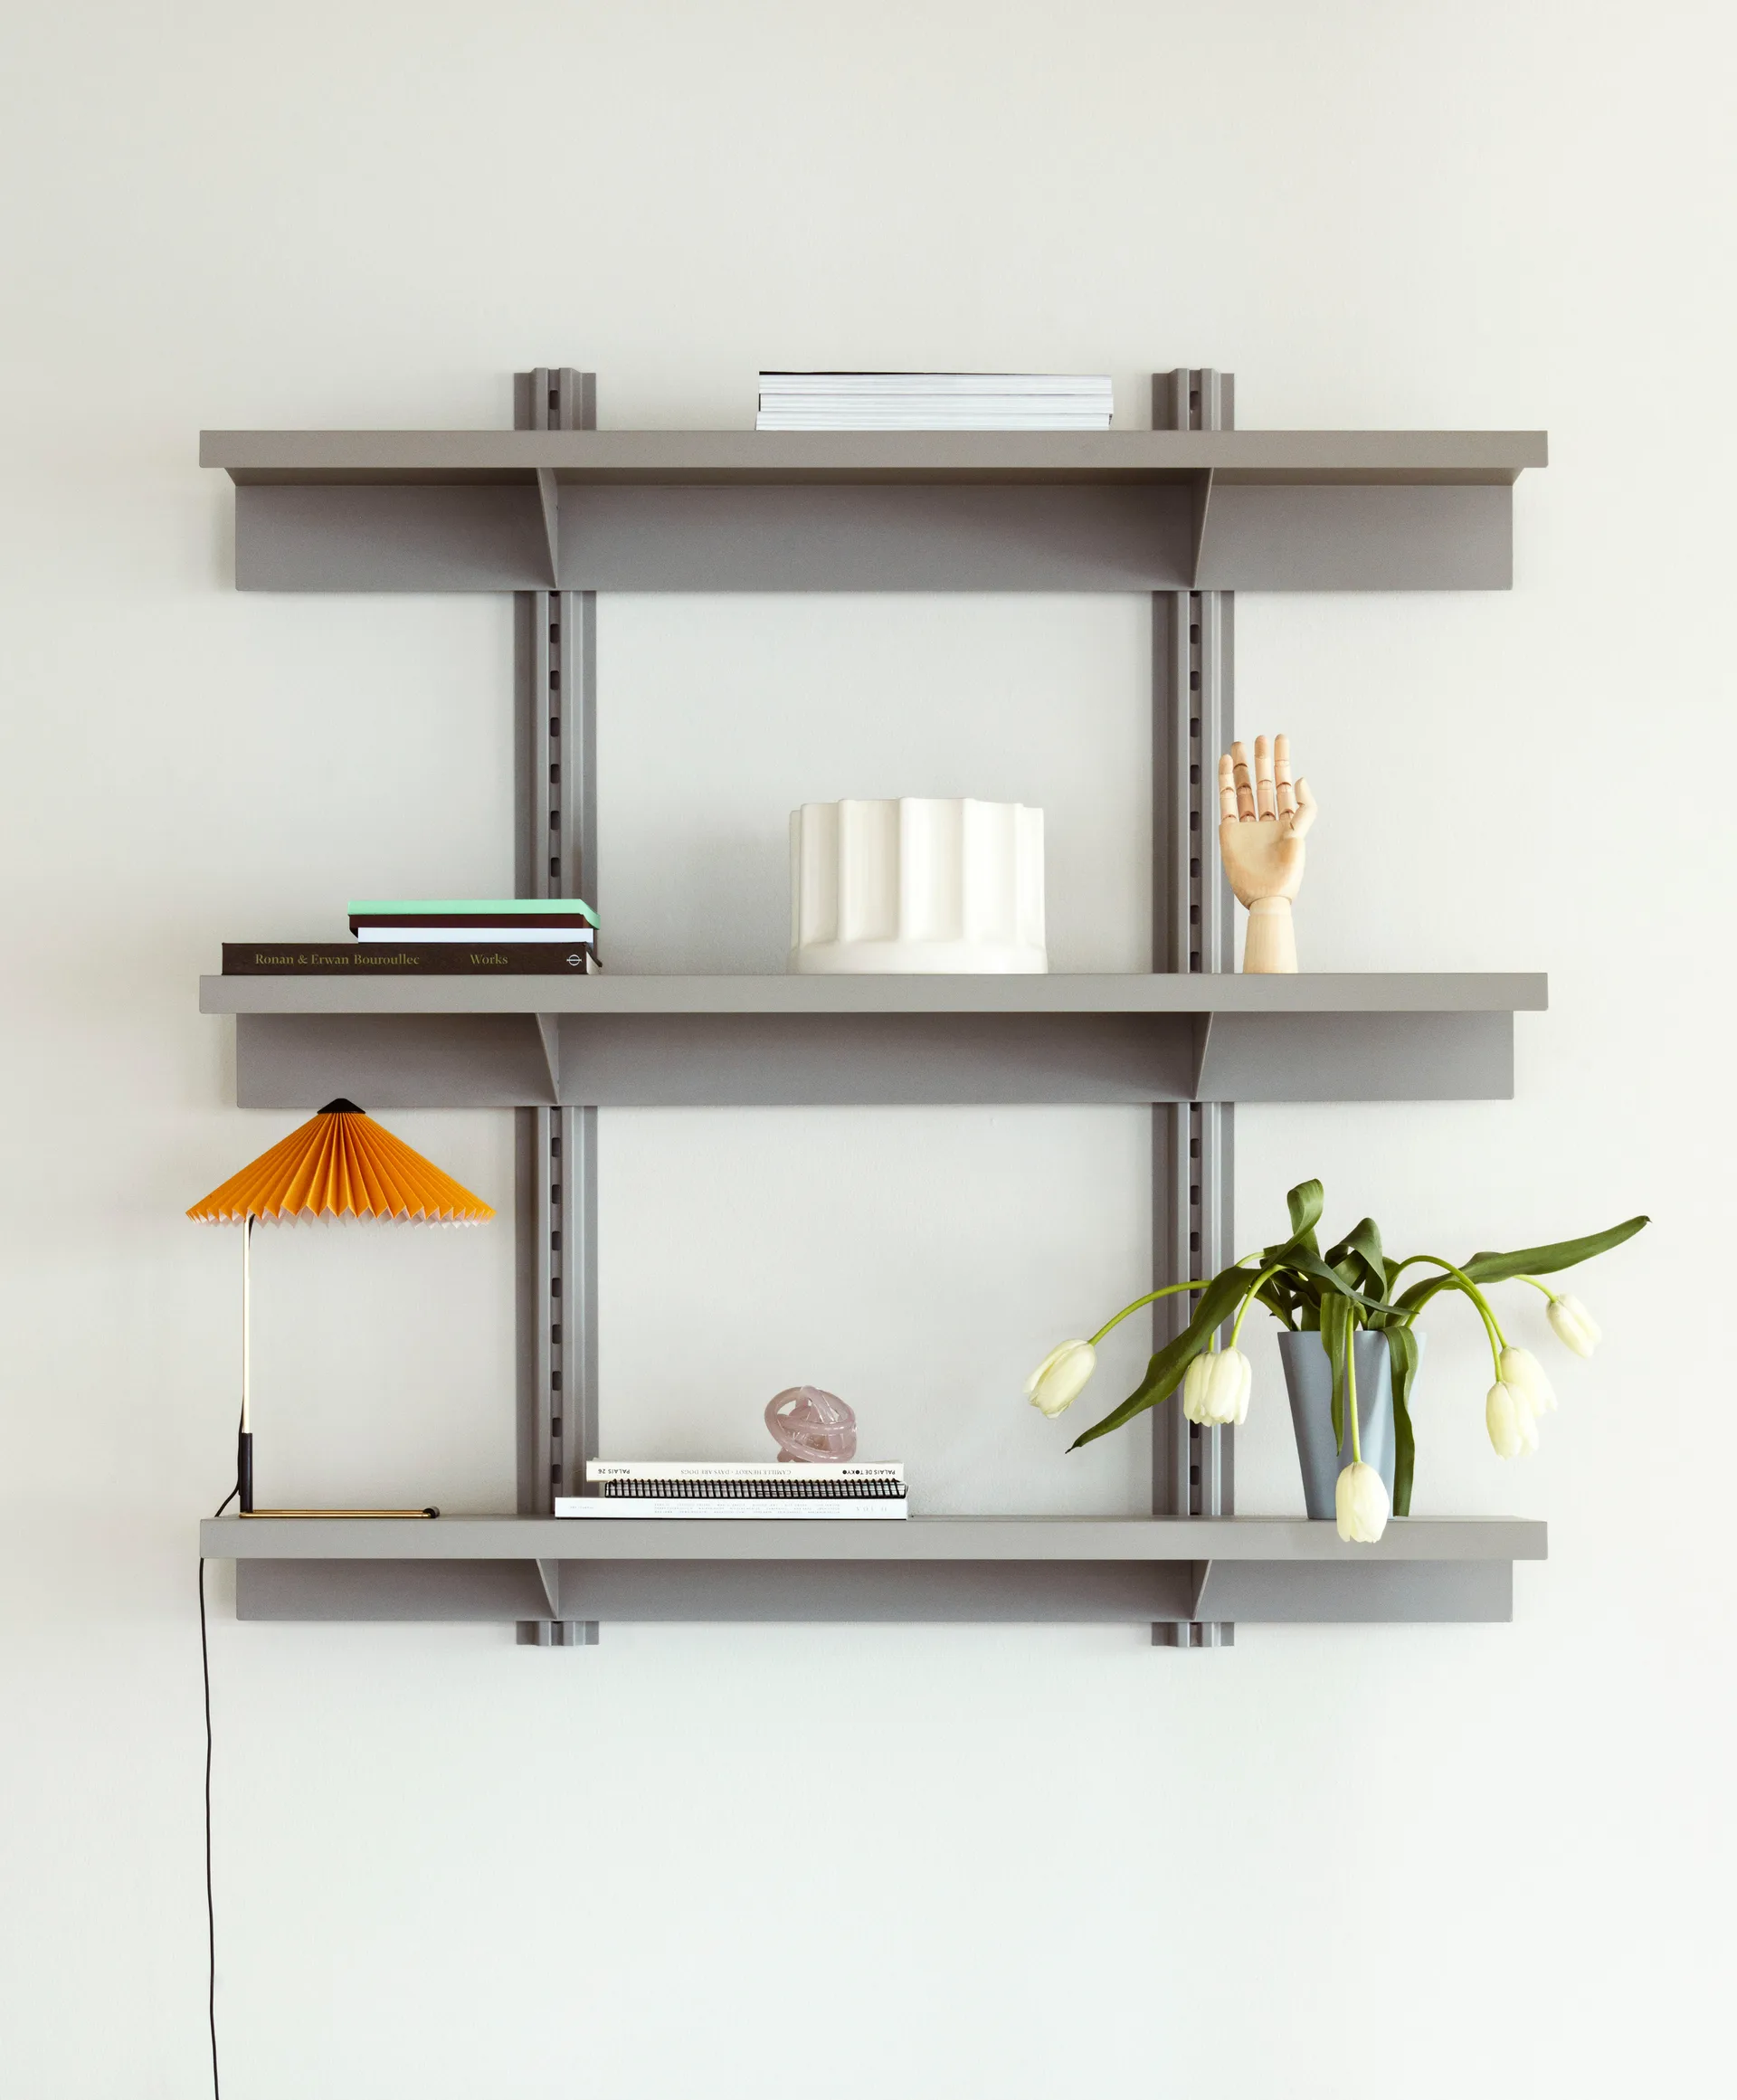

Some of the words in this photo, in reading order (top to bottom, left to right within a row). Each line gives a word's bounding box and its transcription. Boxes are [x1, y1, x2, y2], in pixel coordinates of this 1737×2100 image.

[255, 954, 294, 965] Ronan
[298, 955, 308, 964] &
[311, 954, 349, 965] Erwan
[354, 953, 420, 965] Bouroullec
[470, 953, 508, 964] Works
